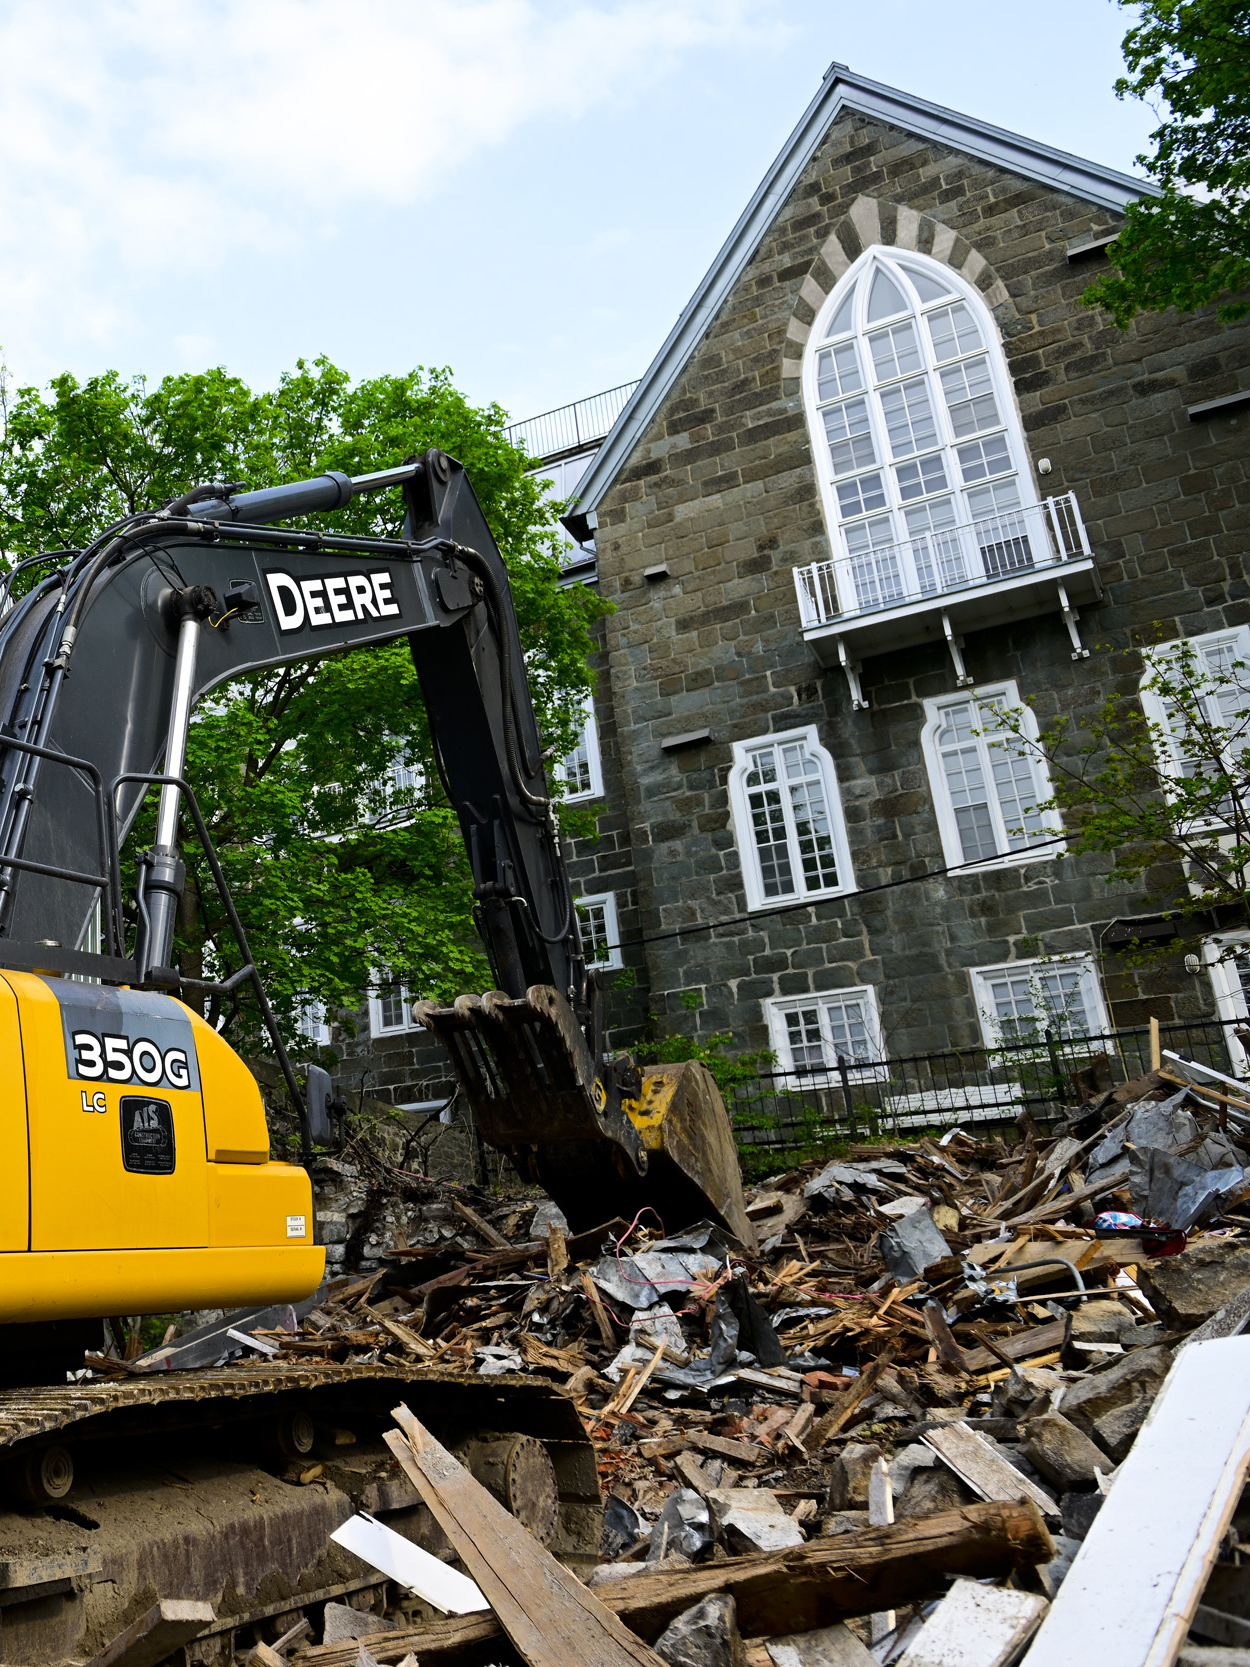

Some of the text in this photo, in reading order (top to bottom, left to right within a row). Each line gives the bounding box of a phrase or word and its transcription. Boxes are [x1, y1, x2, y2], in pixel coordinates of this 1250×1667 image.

[265, 571, 400, 630] DEERE
[72, 1030, 191, 1090] 350G
[81, 1090, 107, 1113] LC
[134, 1104, 160, 1130] AIS
